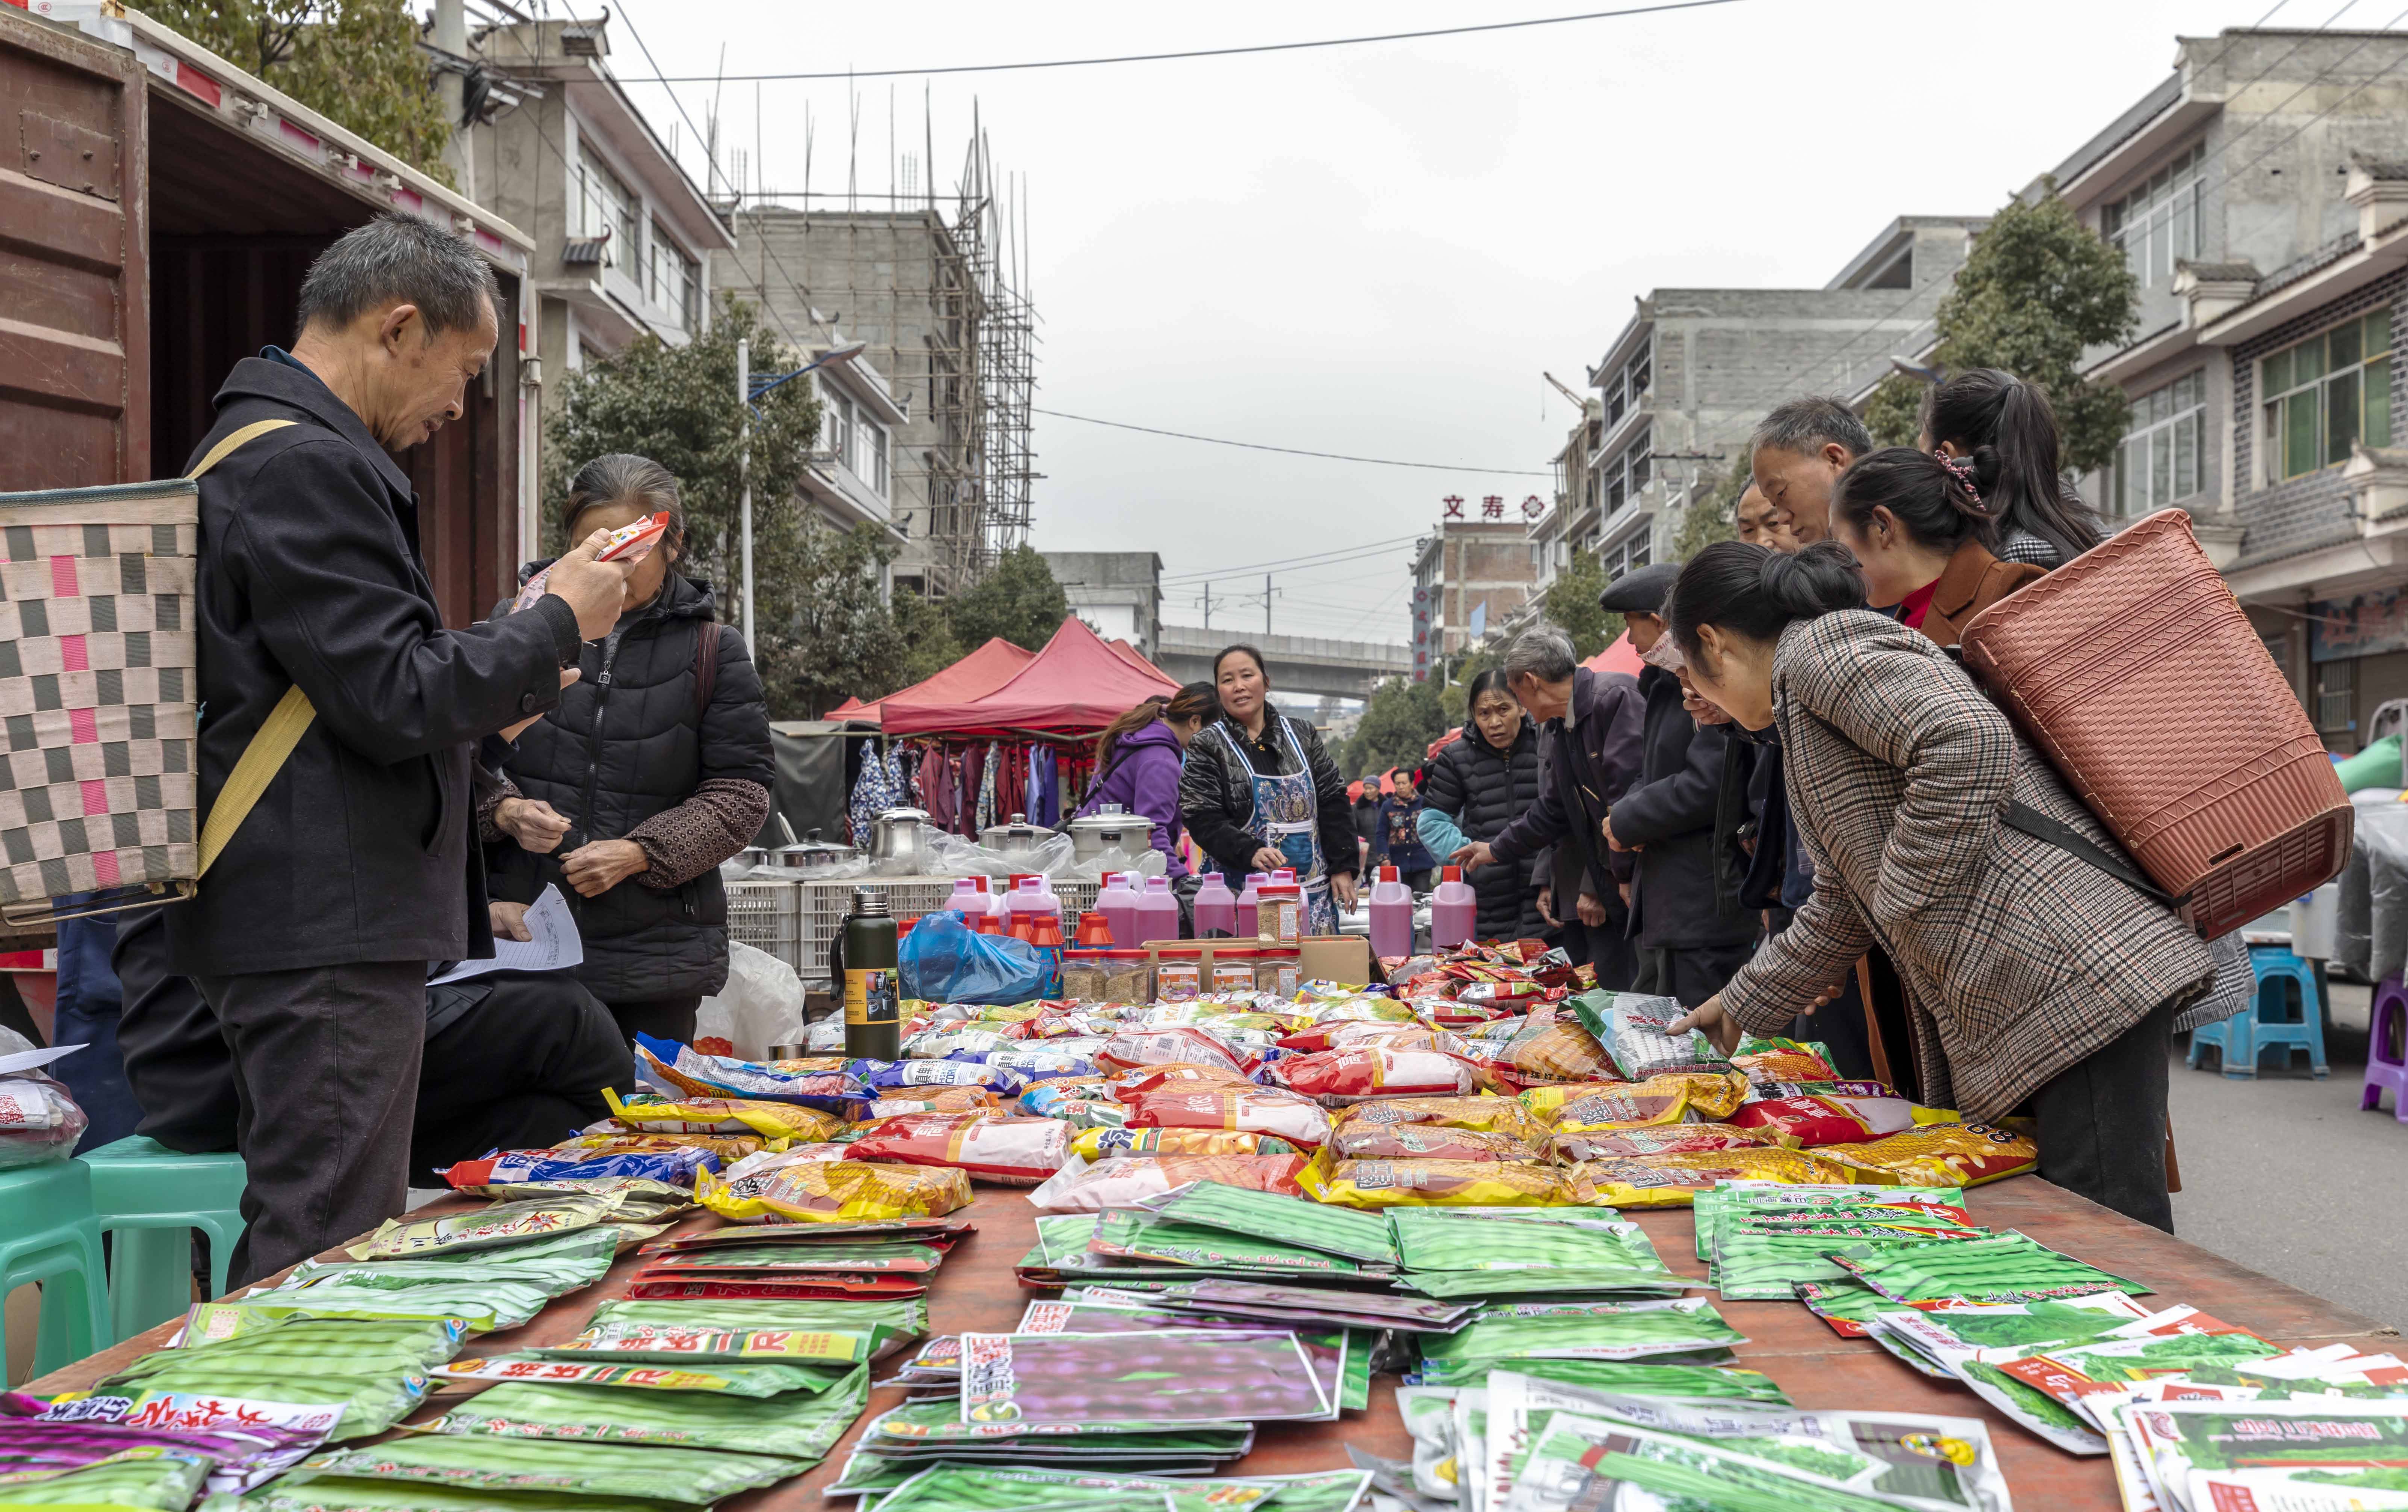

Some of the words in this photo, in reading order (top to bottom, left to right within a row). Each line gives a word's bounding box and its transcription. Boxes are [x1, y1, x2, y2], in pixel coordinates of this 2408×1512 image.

[1443, 494, 1505, 518] 文寿
[1738, 1211, 1856, 1224] 四季架豆王
[1862, 1208, 1908, 1220] 春秋
